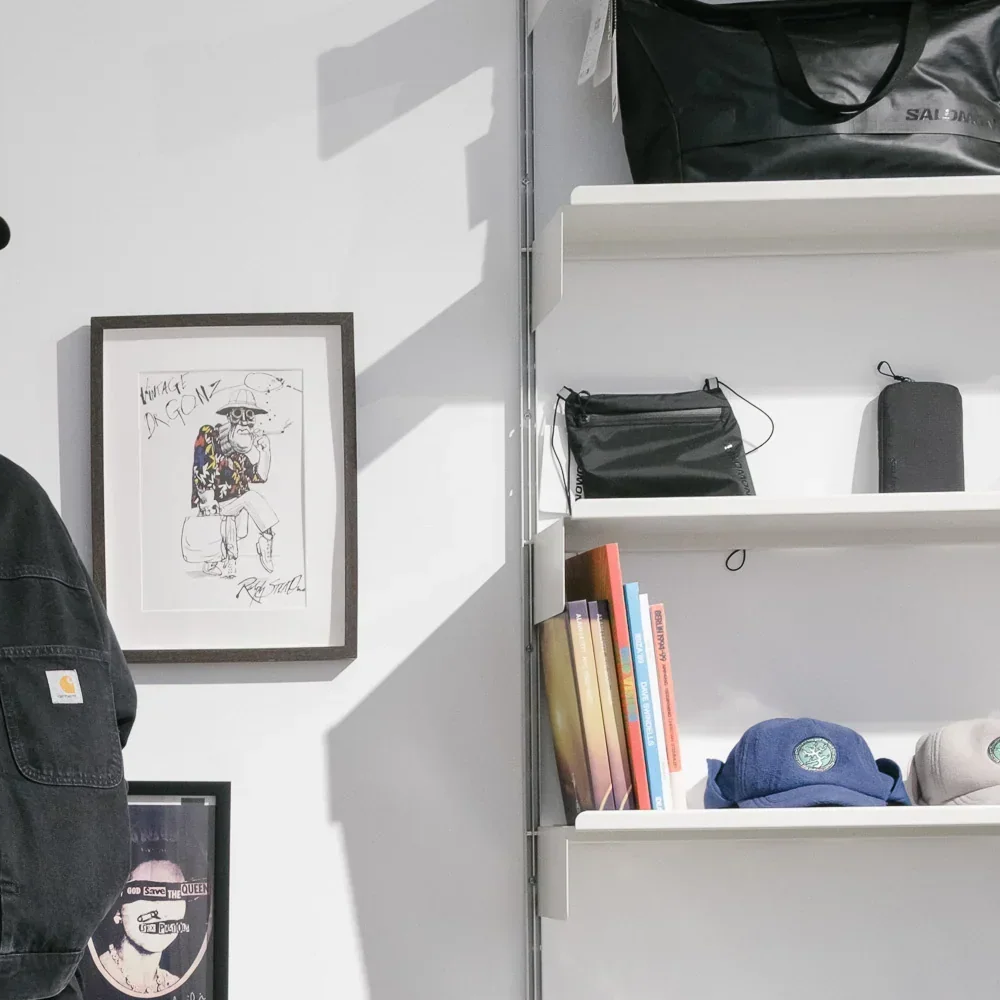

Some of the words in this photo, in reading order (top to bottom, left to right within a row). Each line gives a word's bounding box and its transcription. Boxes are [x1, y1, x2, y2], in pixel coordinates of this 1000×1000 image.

[654, 610, 663, 633] BERLIN
[640, 681, 649, 701] DAVE
[168, 890, 181, 899] THE
[181, 883, 207, 894] QUEEN
